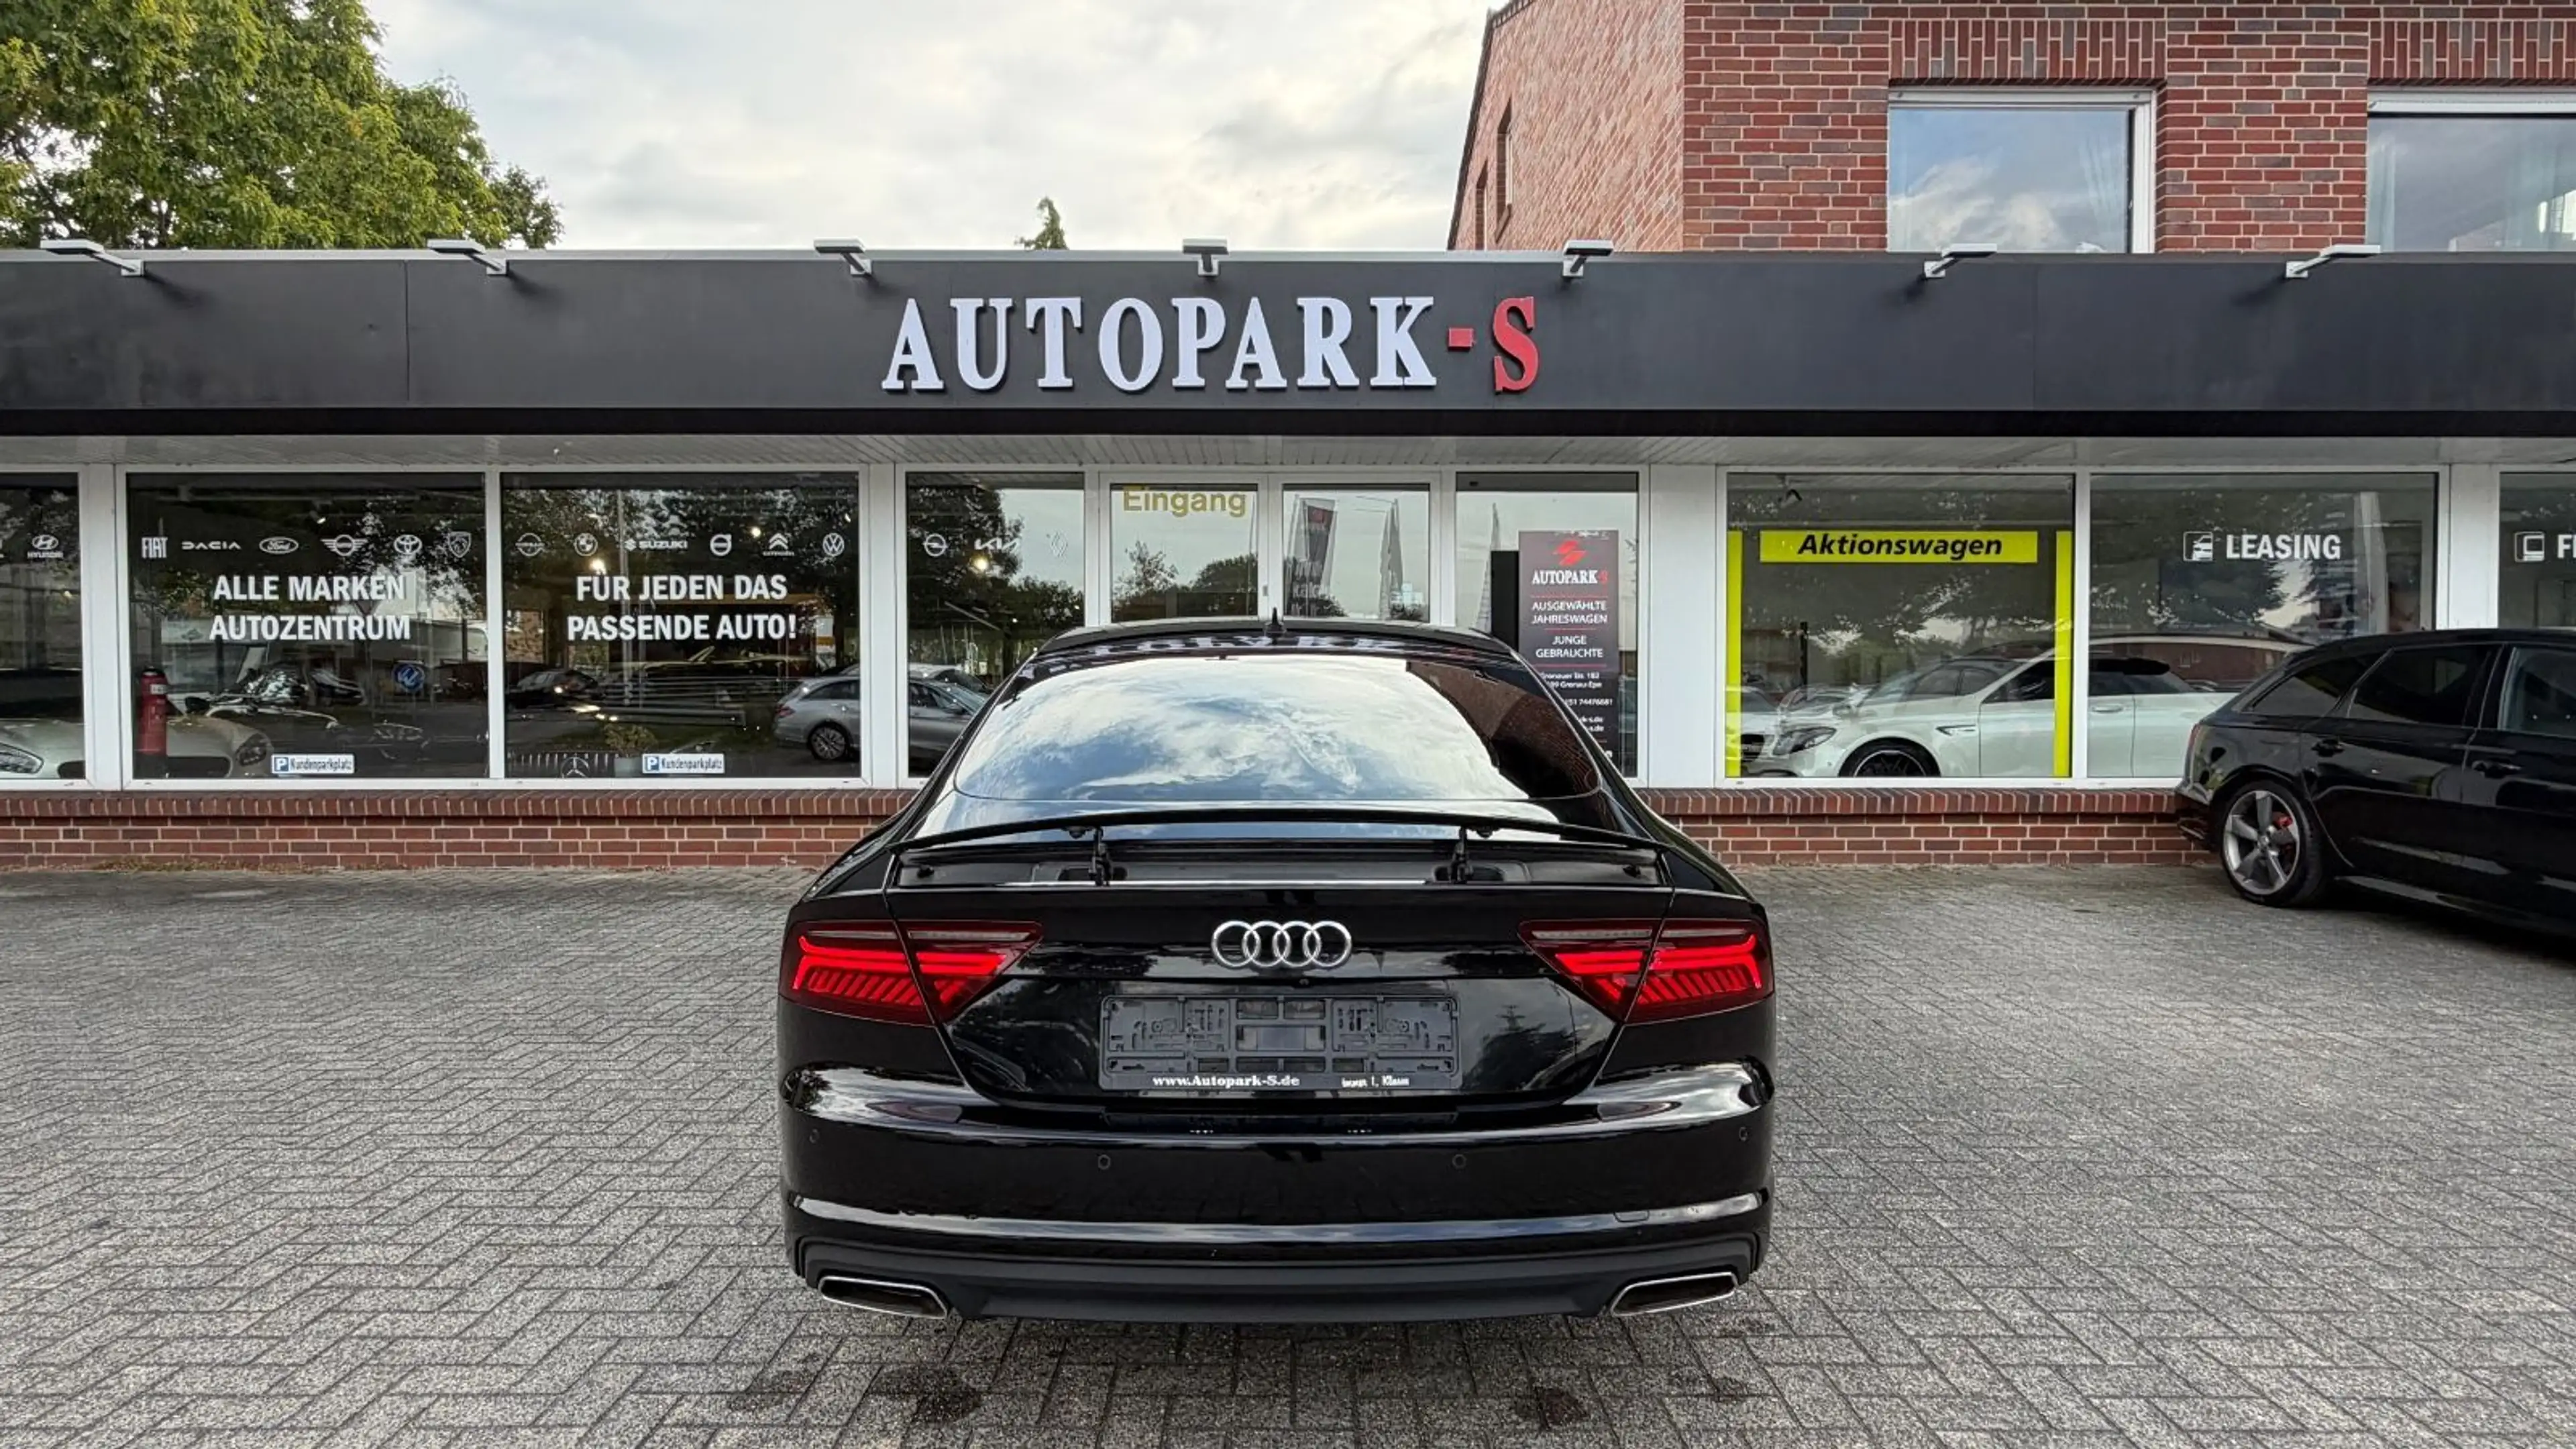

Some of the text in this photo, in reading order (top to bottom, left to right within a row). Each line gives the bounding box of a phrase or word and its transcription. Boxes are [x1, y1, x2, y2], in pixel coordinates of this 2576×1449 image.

[1123, 486, 1246, 517] Eingang
[142, 537, 168, 558] FIAT
[638, 539, 688, 549] SUZUKI
[1797, 533, 2002, 561] Aktionswagen
[2226, 535, 2341, 560] LEASING
[214, 575, 405, 600] ALLE MARKEN
[639, 574, 724, 600] JEDEN
[734, 574, 788, 600] DAS
[209, 614, 411, 641] AUTOZENTRUM
[568, 614, 796, 641] PASSENDE AUTO!
[1532, 614, 1608, 625] JAHRESWAGEN
[1552, 635, 1587, 645] JUNGE
[1536, 648, 1603, 658] GEBRAUCHTE
[1152, 1075, 1300, 1089] www.Autopark-S.de
